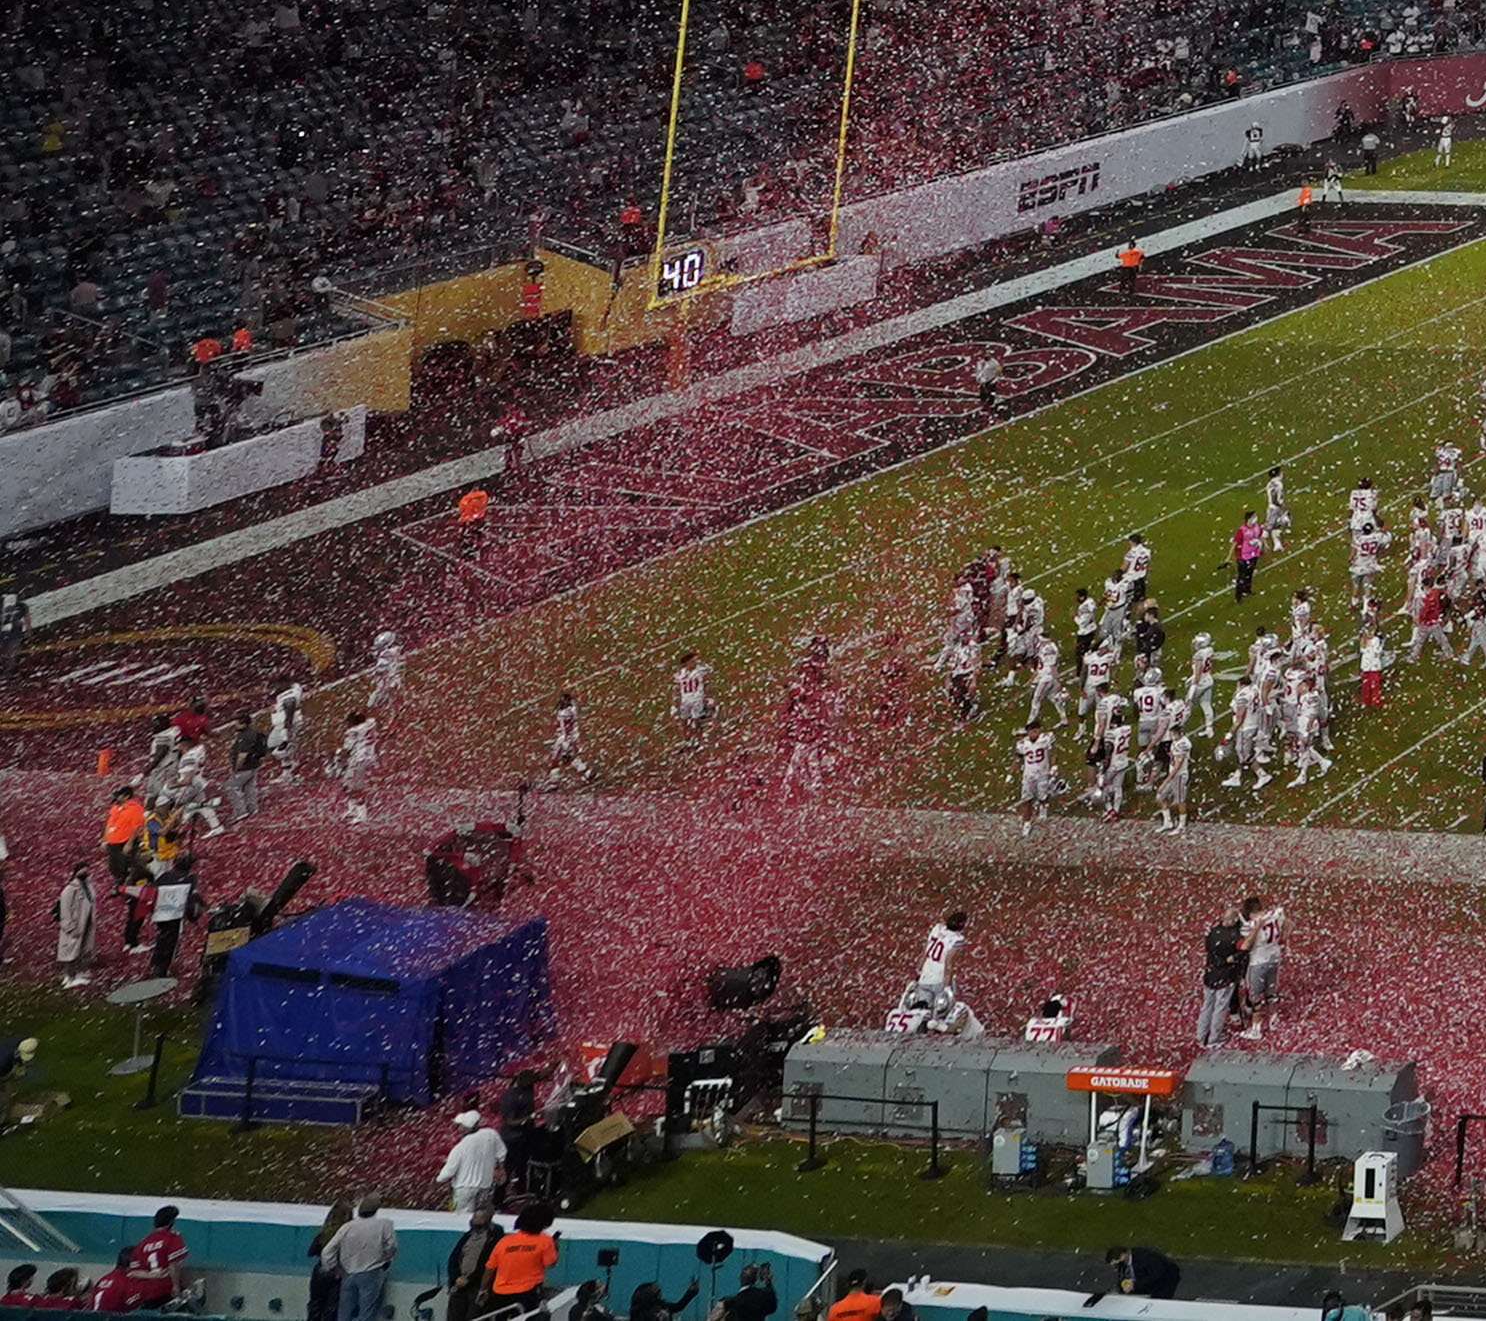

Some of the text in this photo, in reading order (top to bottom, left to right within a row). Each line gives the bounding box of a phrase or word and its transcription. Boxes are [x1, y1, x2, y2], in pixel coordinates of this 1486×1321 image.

[1018, 162, 1100, 213] ESPN
[663, 253, 702, 289] 40
[930, 936, 945, 962] 70
[1031, 1027, 1055, 1041] 77
[1090, 1075, 1150, 1091] GATORADE
